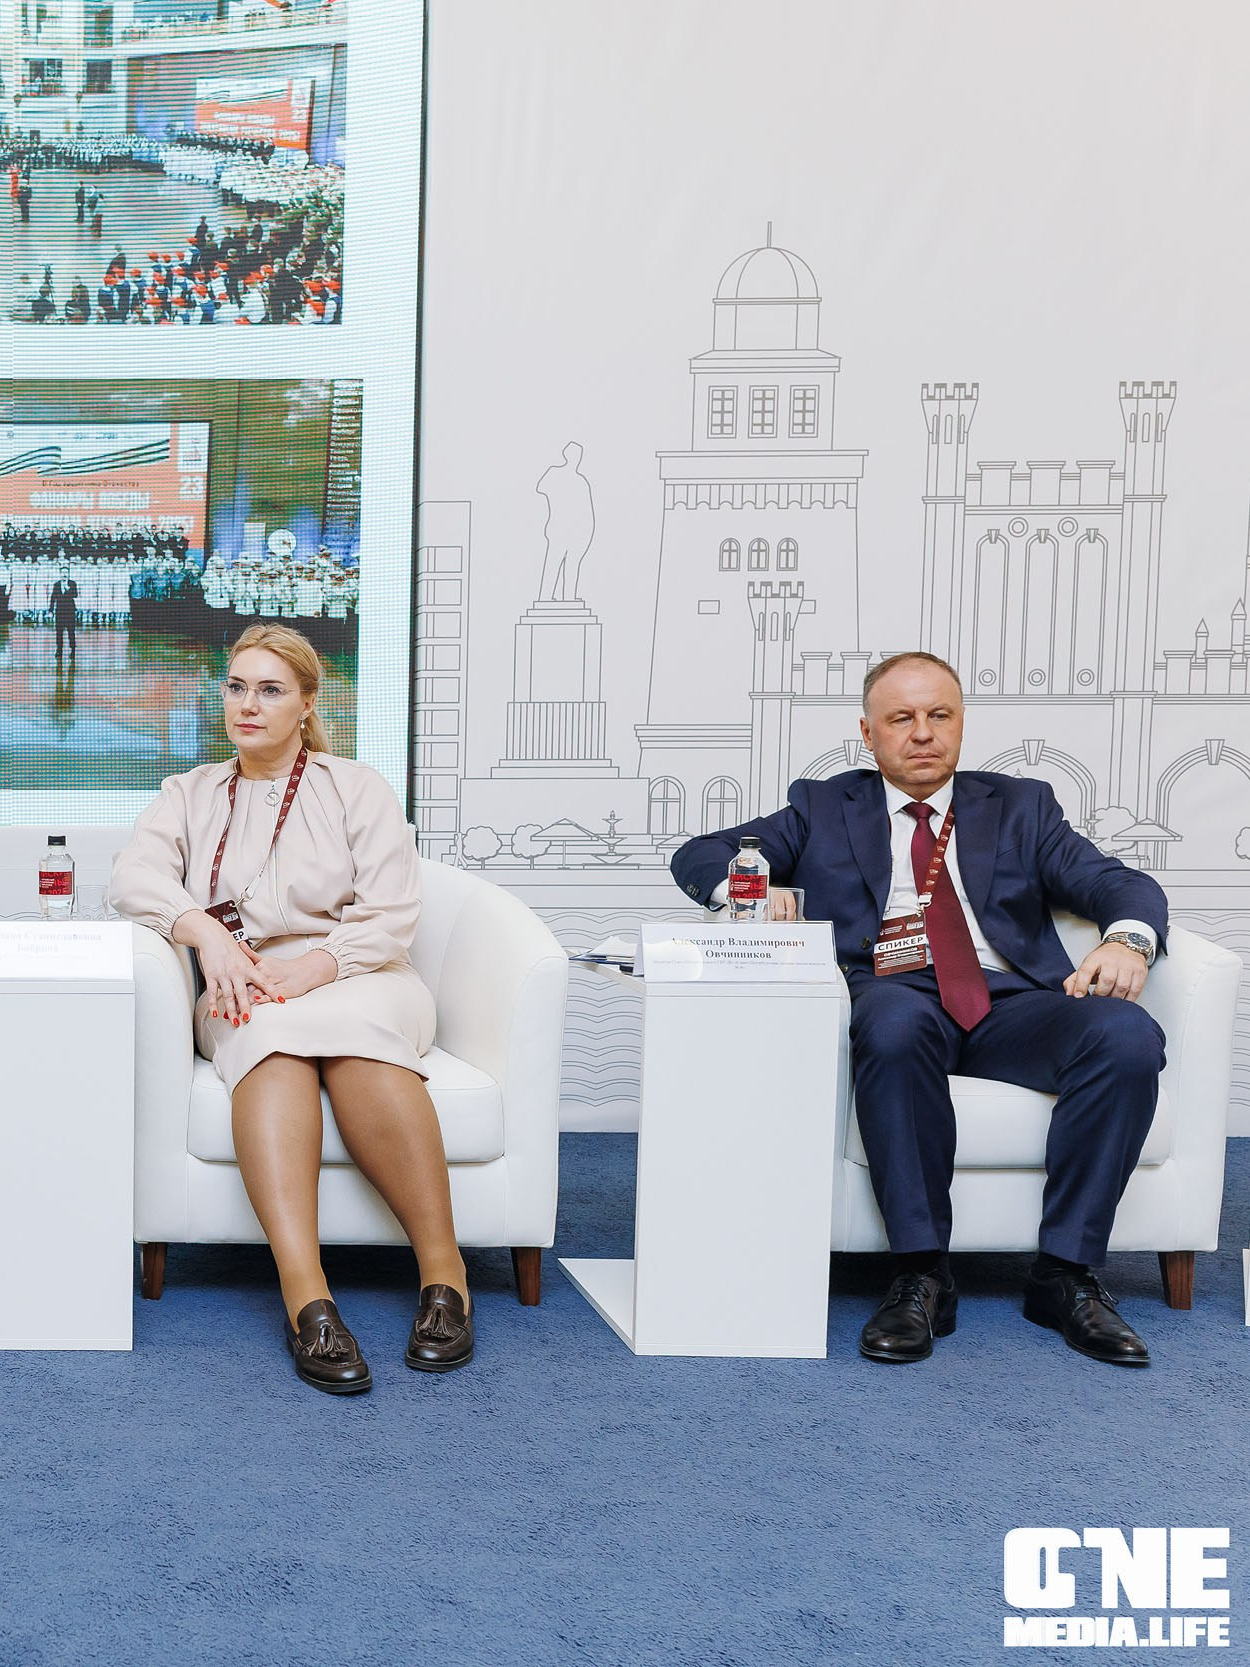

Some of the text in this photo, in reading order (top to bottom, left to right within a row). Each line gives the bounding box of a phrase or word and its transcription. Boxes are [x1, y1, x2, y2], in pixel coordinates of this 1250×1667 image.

[672, 937, 806, 948] ександр Владимирович
[878, 936, 924, 951] СПИКЕР
[705, 949, 772, 959] Овчинников
